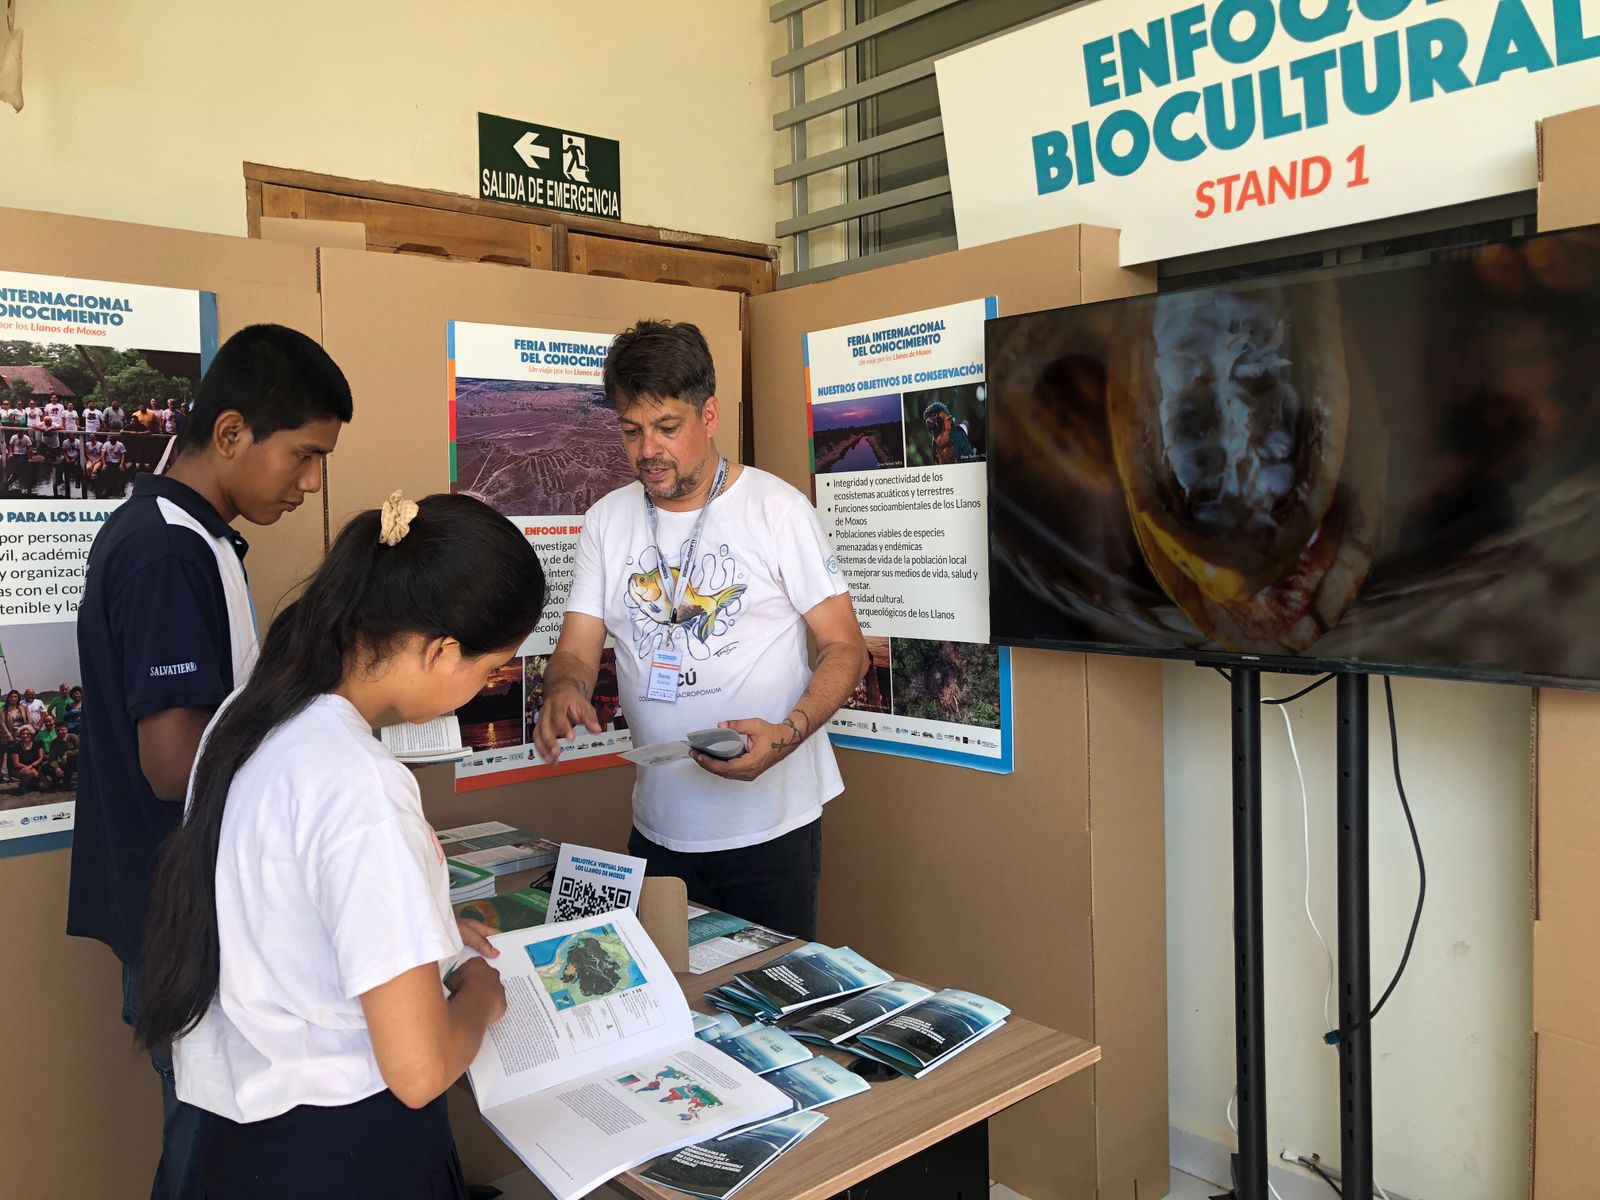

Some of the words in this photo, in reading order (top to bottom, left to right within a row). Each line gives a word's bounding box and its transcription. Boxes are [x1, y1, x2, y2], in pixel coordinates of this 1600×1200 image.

[1083, 0, 1449, 107] ENFOQ
[1032, 0, 1600, 196] BIOCULTURAL
[1194, 154, 1332, 219] STAND
[1346, 144, 1371, 188] 1
[482, 168, 526, 201] SALIDA
[528, 176, 544, 204] DE
[546, 179, 620, 217] EMERGENCIA
[16, 322, 28, 330] los
[31, 323, 61, 334] Llanos
[63, 324, 75, 334] de
[77, 326, 106, 337] Moxos
[847, 332, 871, 347] FERIA
[872, 320, 946, 343] INTERNACIONAL
[514, 338, 546, 352] FERIA
[549, 341, 609, 356] INTERNACI
[852, 345, 868, 358] DEL
[869, 333, 941, 354] CONOCIMIENTO
[520, 352, 541, 364] DEL
[539, 367, 553, 376] viaje
[574, 368, 592, 376] Llanos
[818, 382, 856, 396] NUESTROS
[857, 376, 900, 392] OBJETIVOS
[902, 374, 913, 385] DE
[914, 362, 984, 382] CONSERVACIÓN
[833, 478, 868, 488] Integridad
[875, 473, 920, 486] conectividad
[922, 473, 931, 482] de
[932, 472, 943, 482] los
[834, 491, 875, 500] ecosistemas
[877, 489, 909, 499] acuáticos
[911, 490, 916, 498] y
[917, 487, 954, 496] terrestres
[835, 504, 868, 513] Funciones
[870, 500, 931, 512] socioambientales
[933, 500, 942, 509] de
[944, 499, 954, 509] los
[956, 498, 981, 508] Llanos
[7, 512, 48, 522] PARA
[50, 512, 76, 522] LOS
[836, 518, 843, 526] de
[845, 517, 867, 526] Moxos
[524, 526, 567, 536] ENFOQUE
[836, 529, 876, 539] Poblaciones
[878, 529, 902, 538] viables
[903, 529, 912, 537] de
[914, 528, 944, 538] especies
[0, 534, 24, 546] por
[28, 533, 93, 545] personas
[836, 543, 877, 552] amenazadas
[884, 542, 922, 550] endémicas
[550, 555, 561, 564] de
[837, 555, 866, 564] Sistemas
[868, 555, 877, 564] de
[878, 555, 892, 564] vida
[894, 555, 902, 564] de
[904, 555, 910, 564] la
[912, 555, 948, 565] población
[949, 555, 967, 564] local
[854, 568, 880, 578] mejorar
[895, 568, 920, 577] medios
[922, 569, 931, 578] de
[932, 569, 950, 579] vida,
[952, 569, 972, 578] salud
[973, 571, 978, 580] y
[16, 586, 42, 597] con
[45, 583, 57, 595] el
[876, 595, 904, 604] cultural.
[0, 601, 50, 615] tenible
[54, 604, 62, 615] y
[859, 607, 907, 617] arqueológicos
[908, 608, 917, 617] de
[919, 609, 929, 618] los
[931, 609, 954, 620] Llanos
[571, 856, 596, 866] BIBLIOTECA
[598, 861, 616, 871] VIRTUAL
[617, 866, 632, 874] SOBRE
[584, 866, 601, 875] LLANOS
